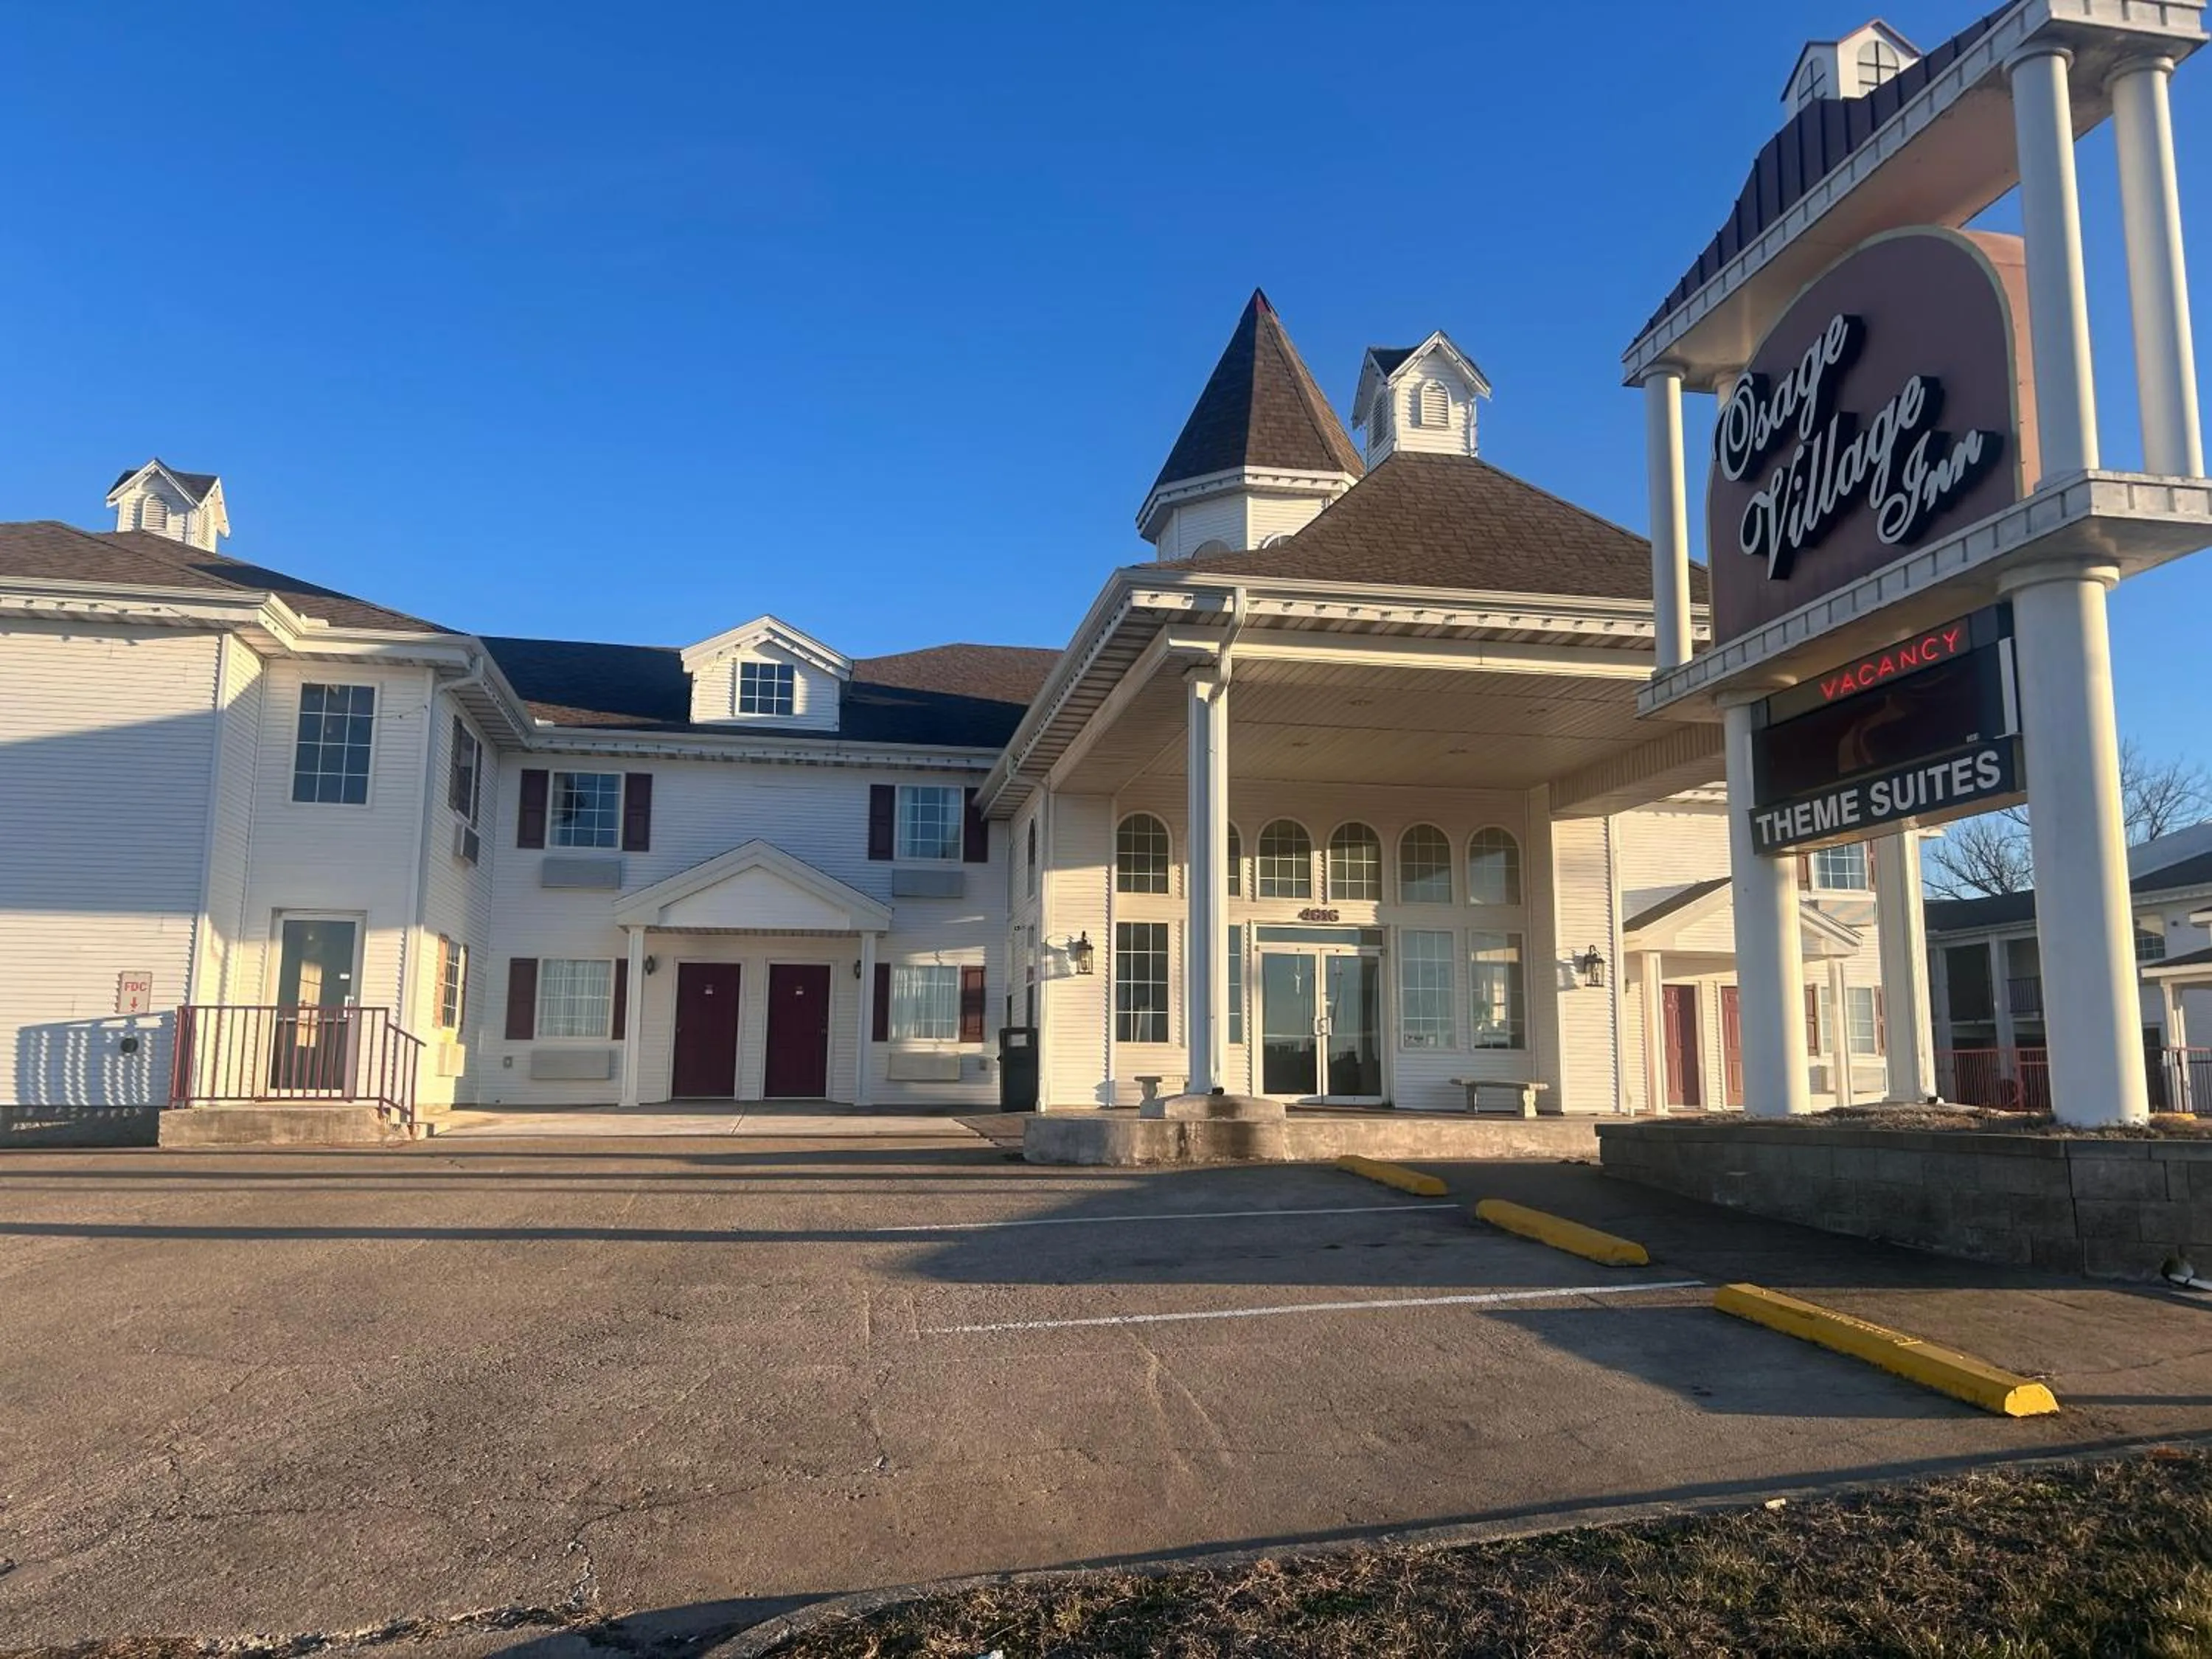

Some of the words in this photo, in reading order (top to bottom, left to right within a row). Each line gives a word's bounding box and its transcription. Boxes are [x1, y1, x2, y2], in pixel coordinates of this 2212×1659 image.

[1717, 313, 1849, 481] Osage
[1740, 375, 1925, 580] Village
[1877, 430, 1983, 544] Inn
[1820, 627, 1961, 700] VACANCY
[1756, 788, 1860, 846] THEME
[1869, 750, 2001, 817] SUITES
[124, 981, 147, 992] FDC
